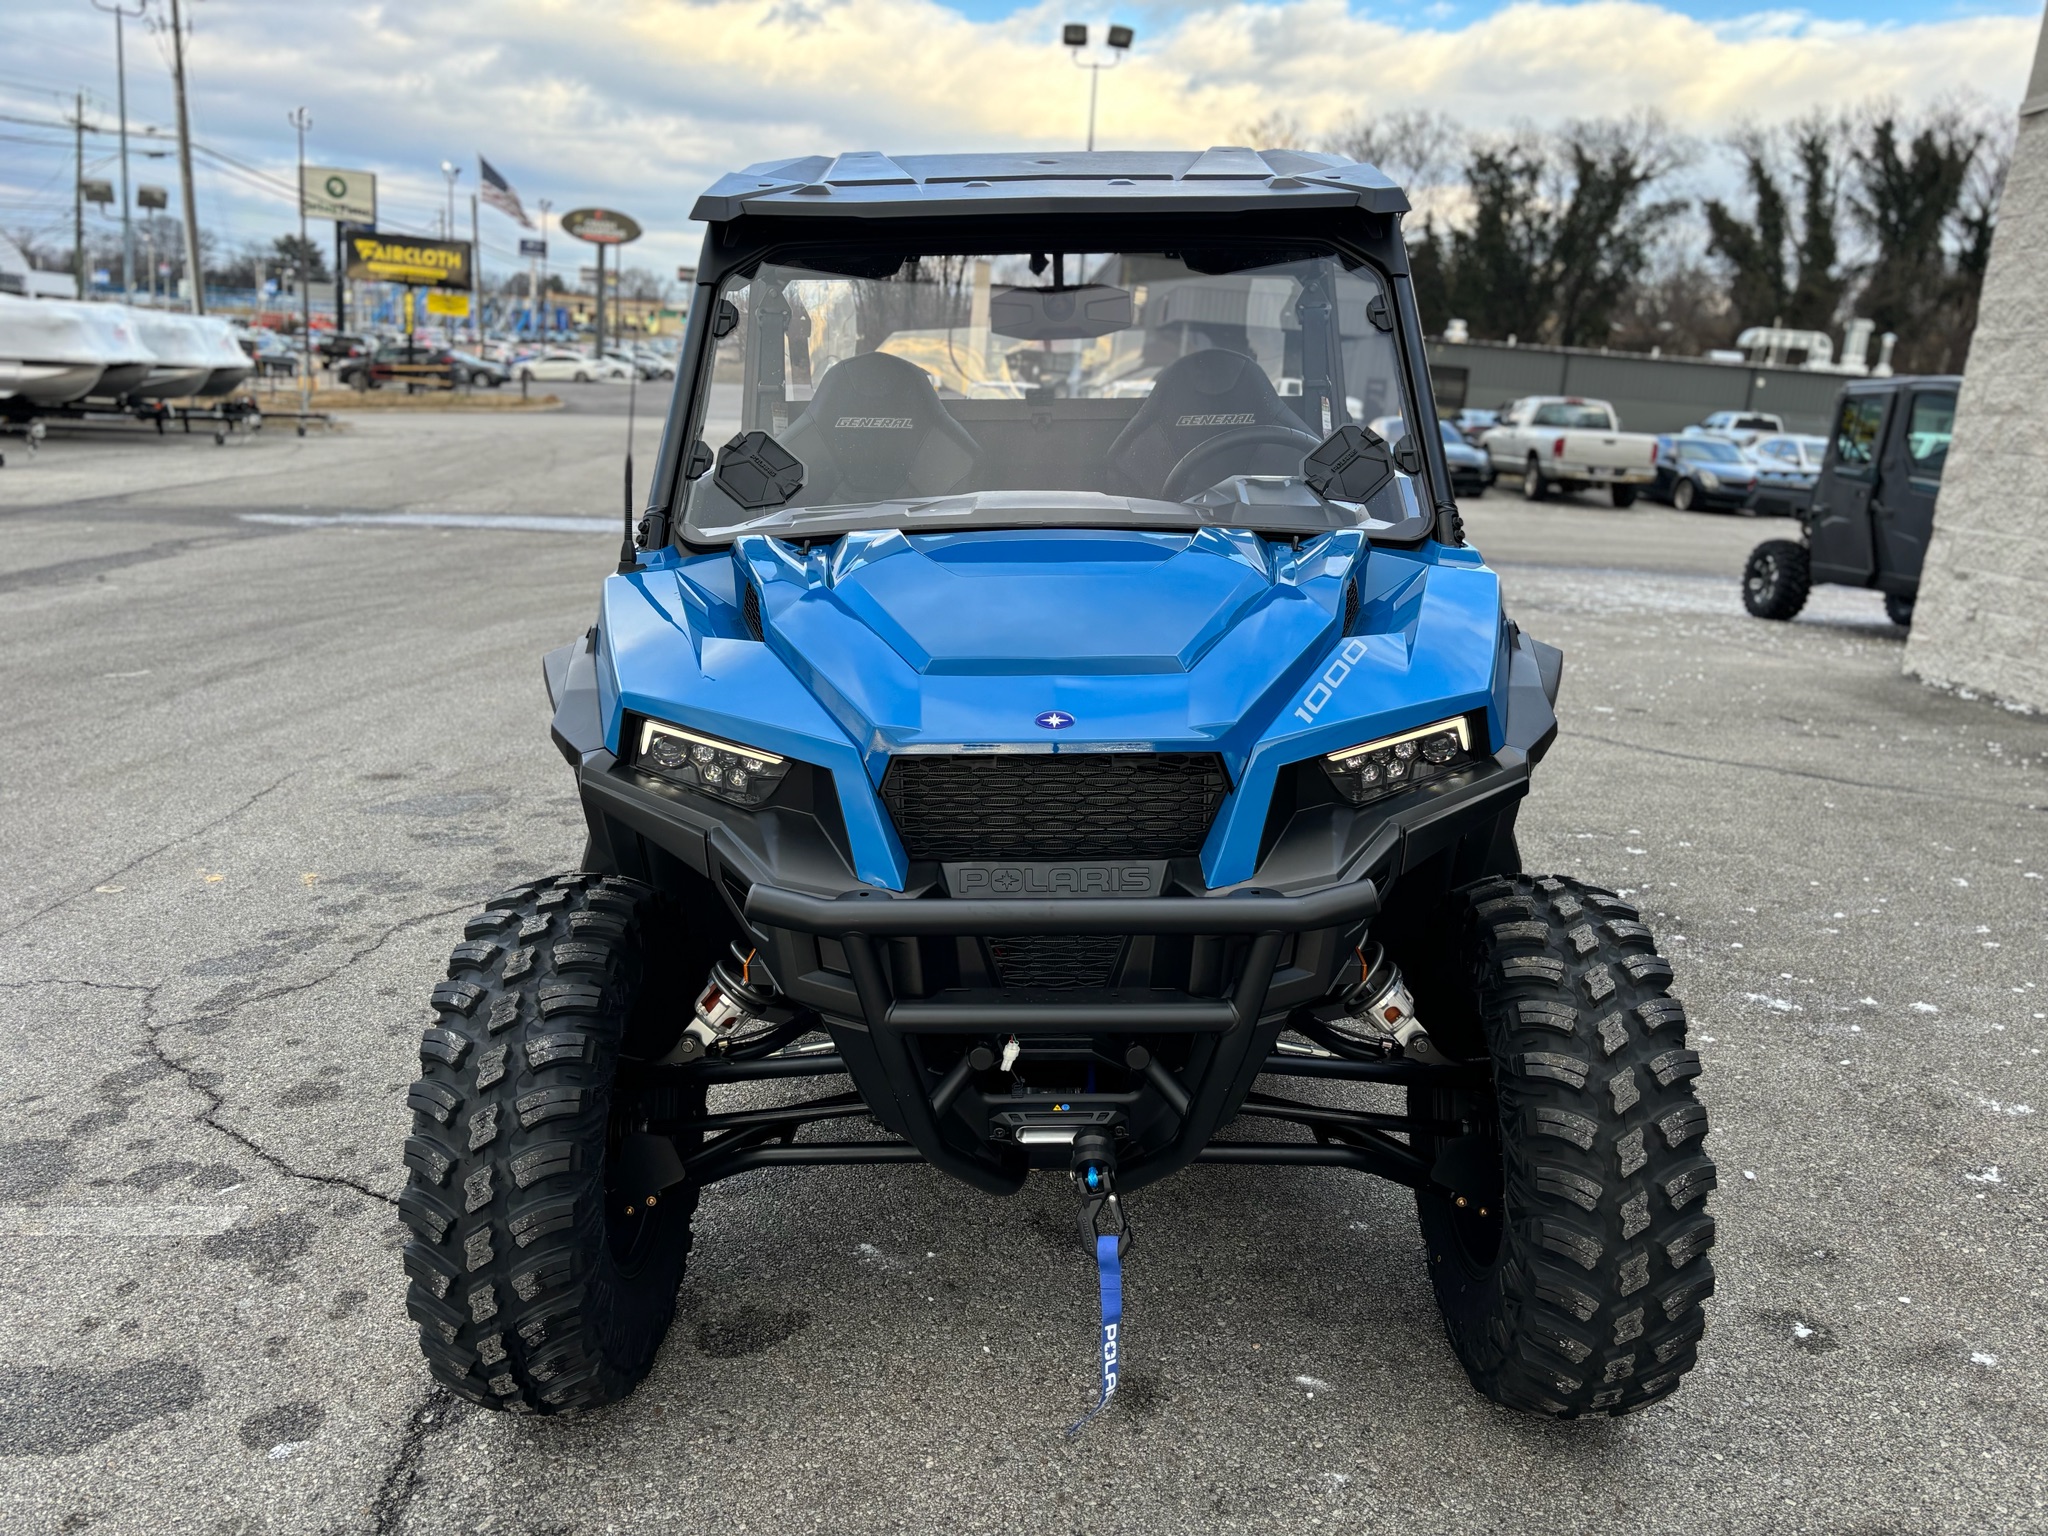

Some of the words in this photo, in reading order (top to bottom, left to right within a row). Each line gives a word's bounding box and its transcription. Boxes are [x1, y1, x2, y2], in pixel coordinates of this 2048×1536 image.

[354, 239, 461, 269] FAIRCLOTH
[835, 416, 913, 429] GENERAL
[1175, 413, 1255, 426] GENERAL
[1294, 638, 1368, 724] 1000
[959, 867, 1151, 893] POLARIS
